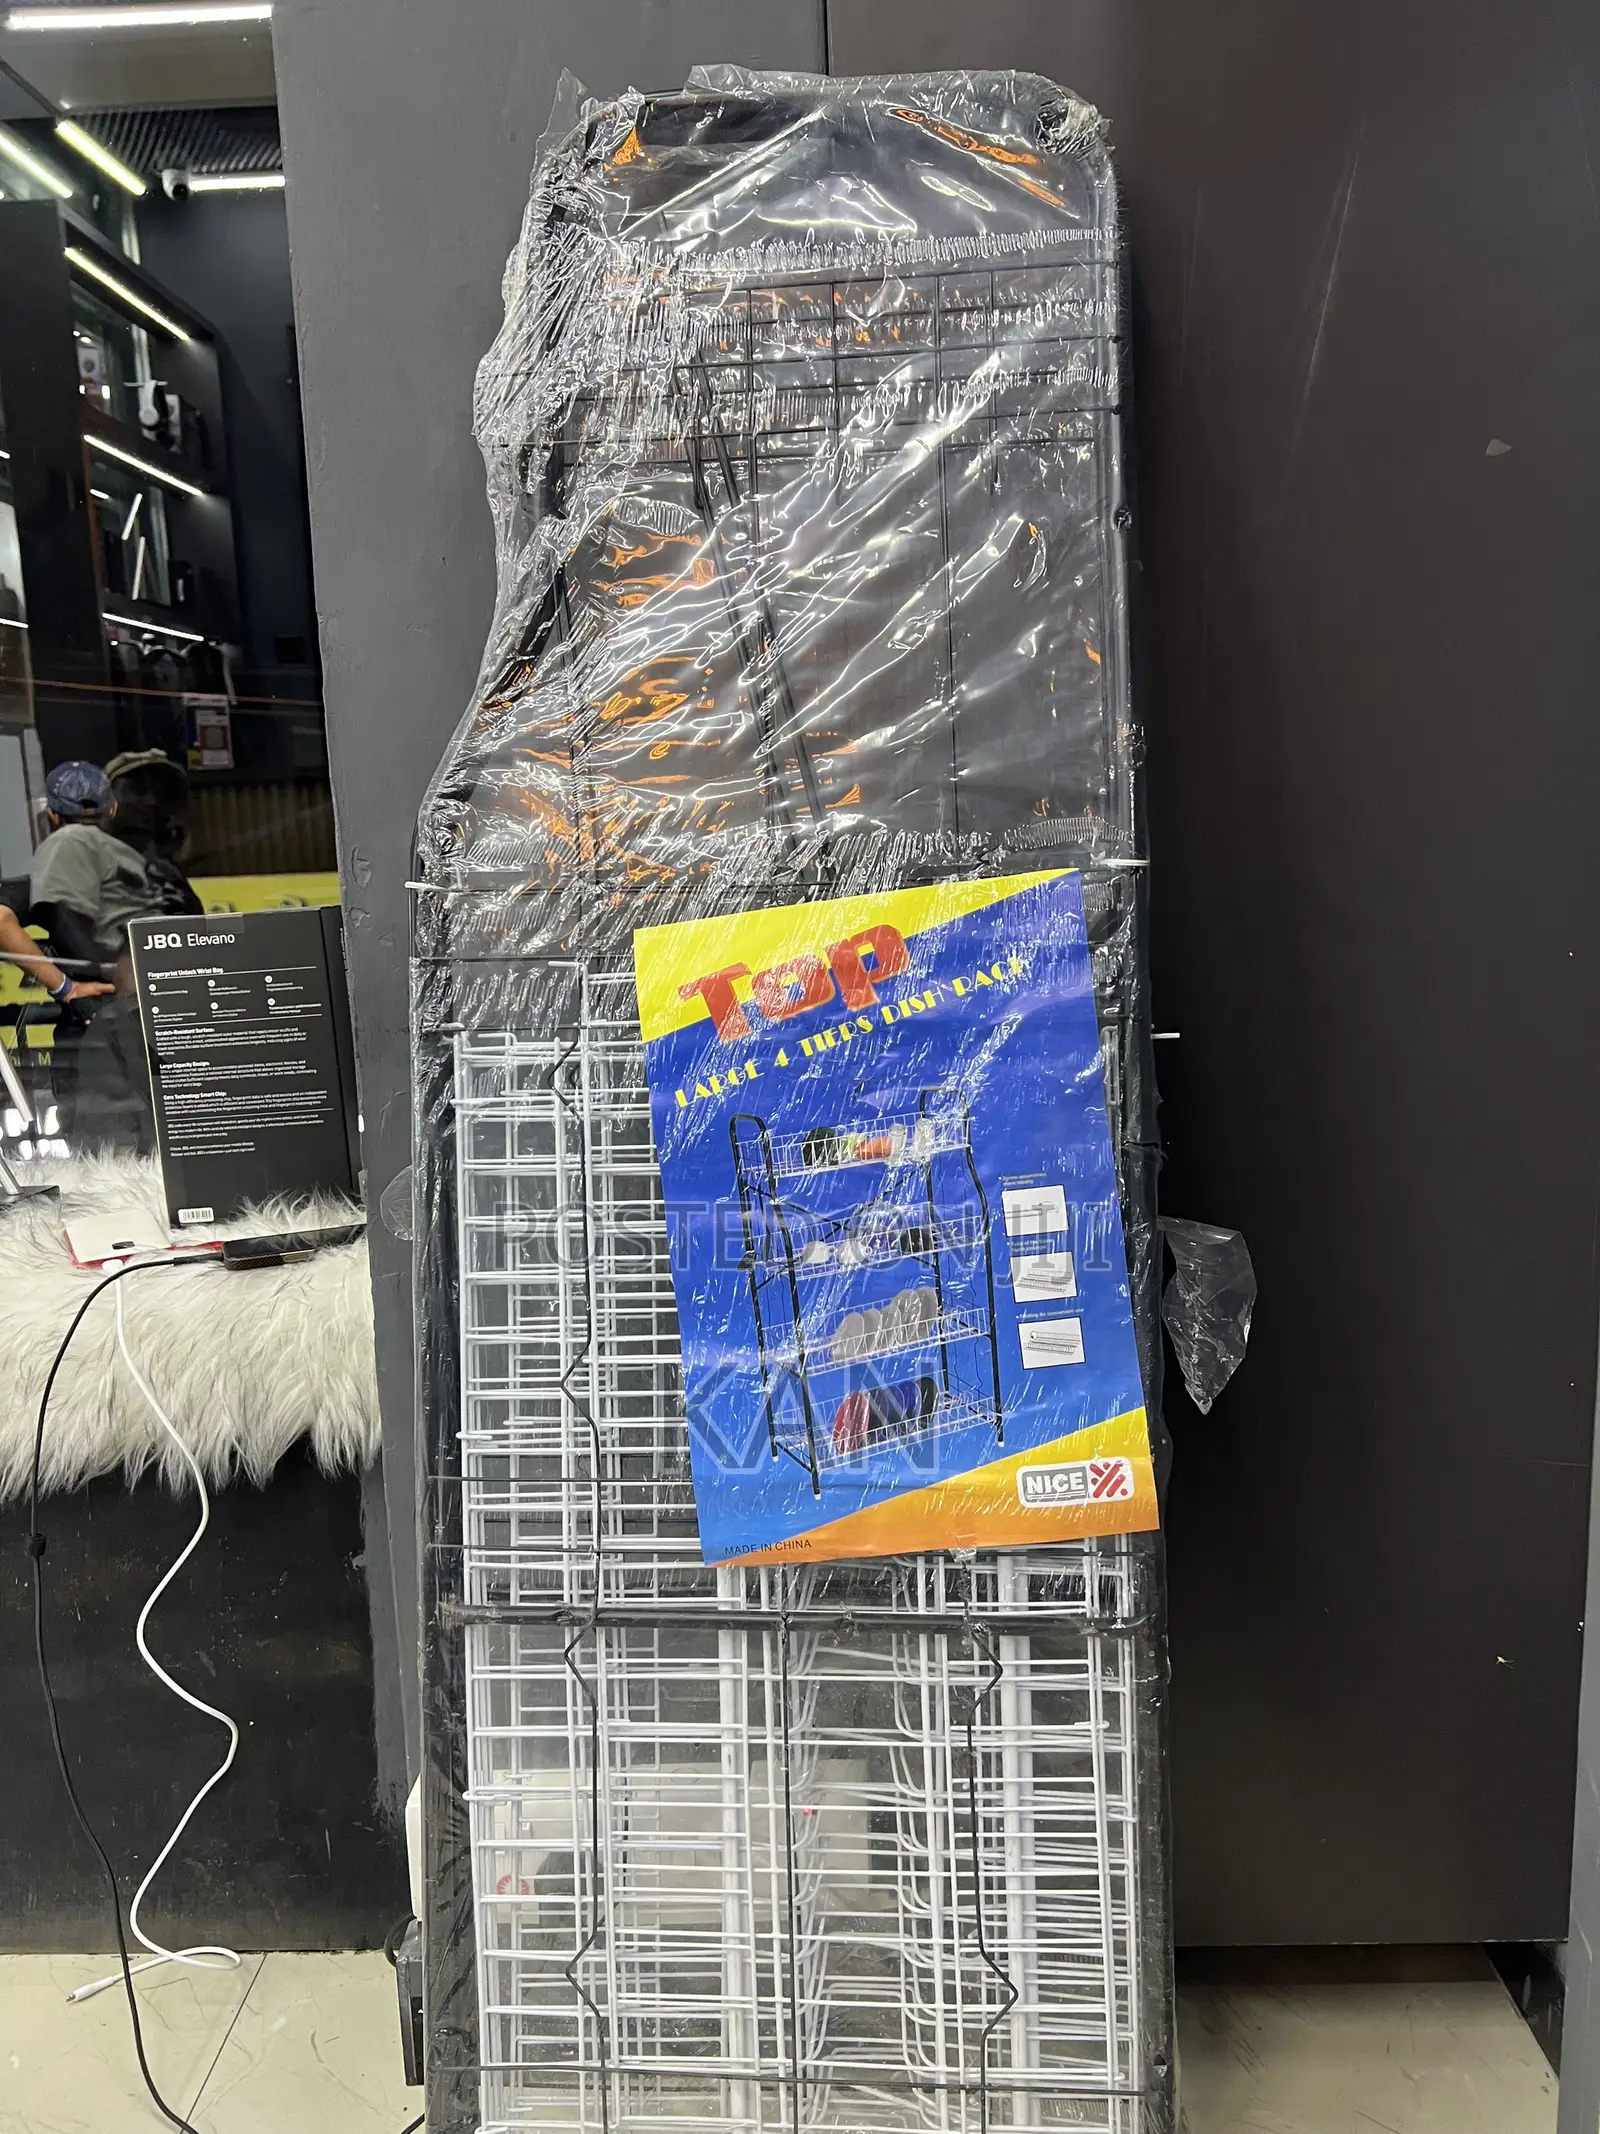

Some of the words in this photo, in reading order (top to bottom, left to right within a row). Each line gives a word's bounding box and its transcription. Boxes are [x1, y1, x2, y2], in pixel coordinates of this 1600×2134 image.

[143, 933, 183, 950] JBQ
[187, 933, 235, 947] Elevano
[147, 971, 178, 979] Fingerprint
[675, 1058, 765, 1108] LARGE
[774, 1048, 790, 1068] 4
[796, 1015, 874, 1057] TIERS
[881, 985, 945, 1025] DISH
[1025, 1471, 1086, 1494] NICE
[724, 1544, 758, 1556] MADE
[760, 1543, 772, 1553] IN
[774, 1539, 812, 1551] CHINA
